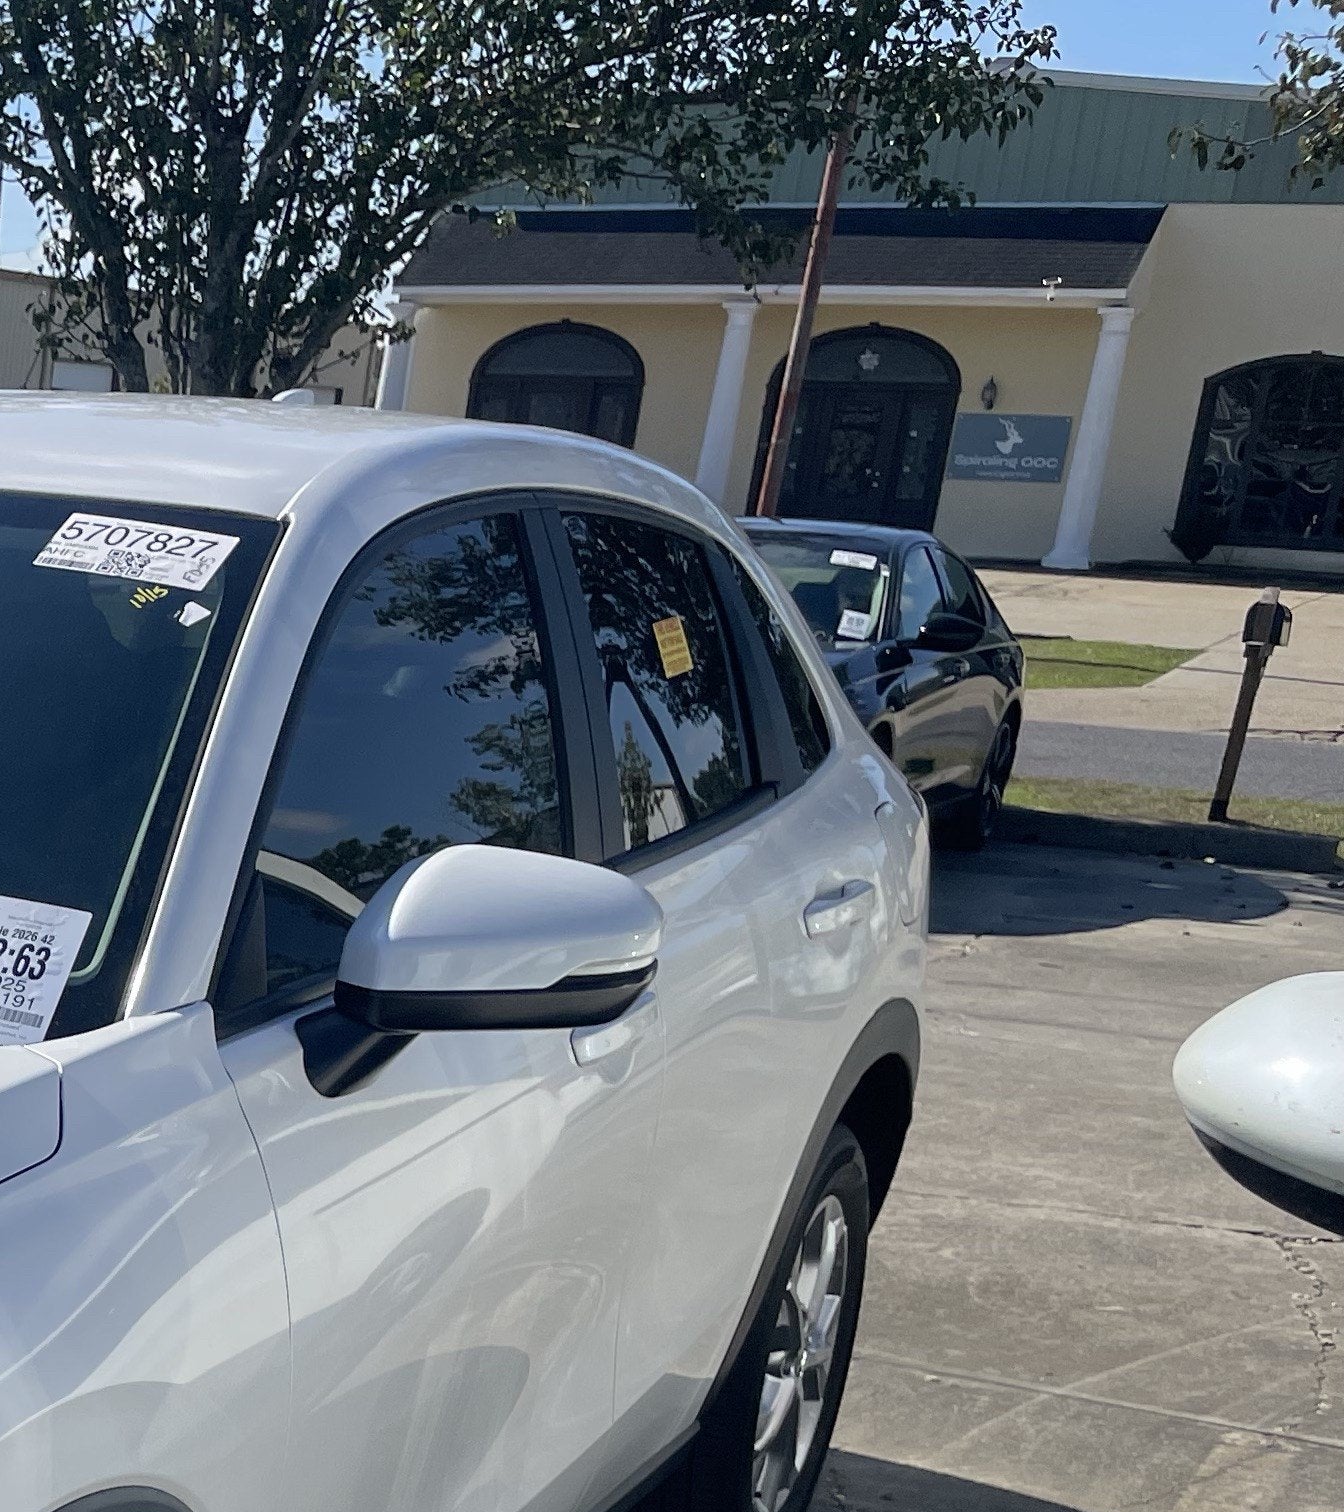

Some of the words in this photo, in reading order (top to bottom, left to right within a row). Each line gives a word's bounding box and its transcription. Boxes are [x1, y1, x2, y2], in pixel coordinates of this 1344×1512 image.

[60, 520, 219, 560] 5707827
[11, 928, 39, 941] 2026
[40, 934, 55, 945] 42
